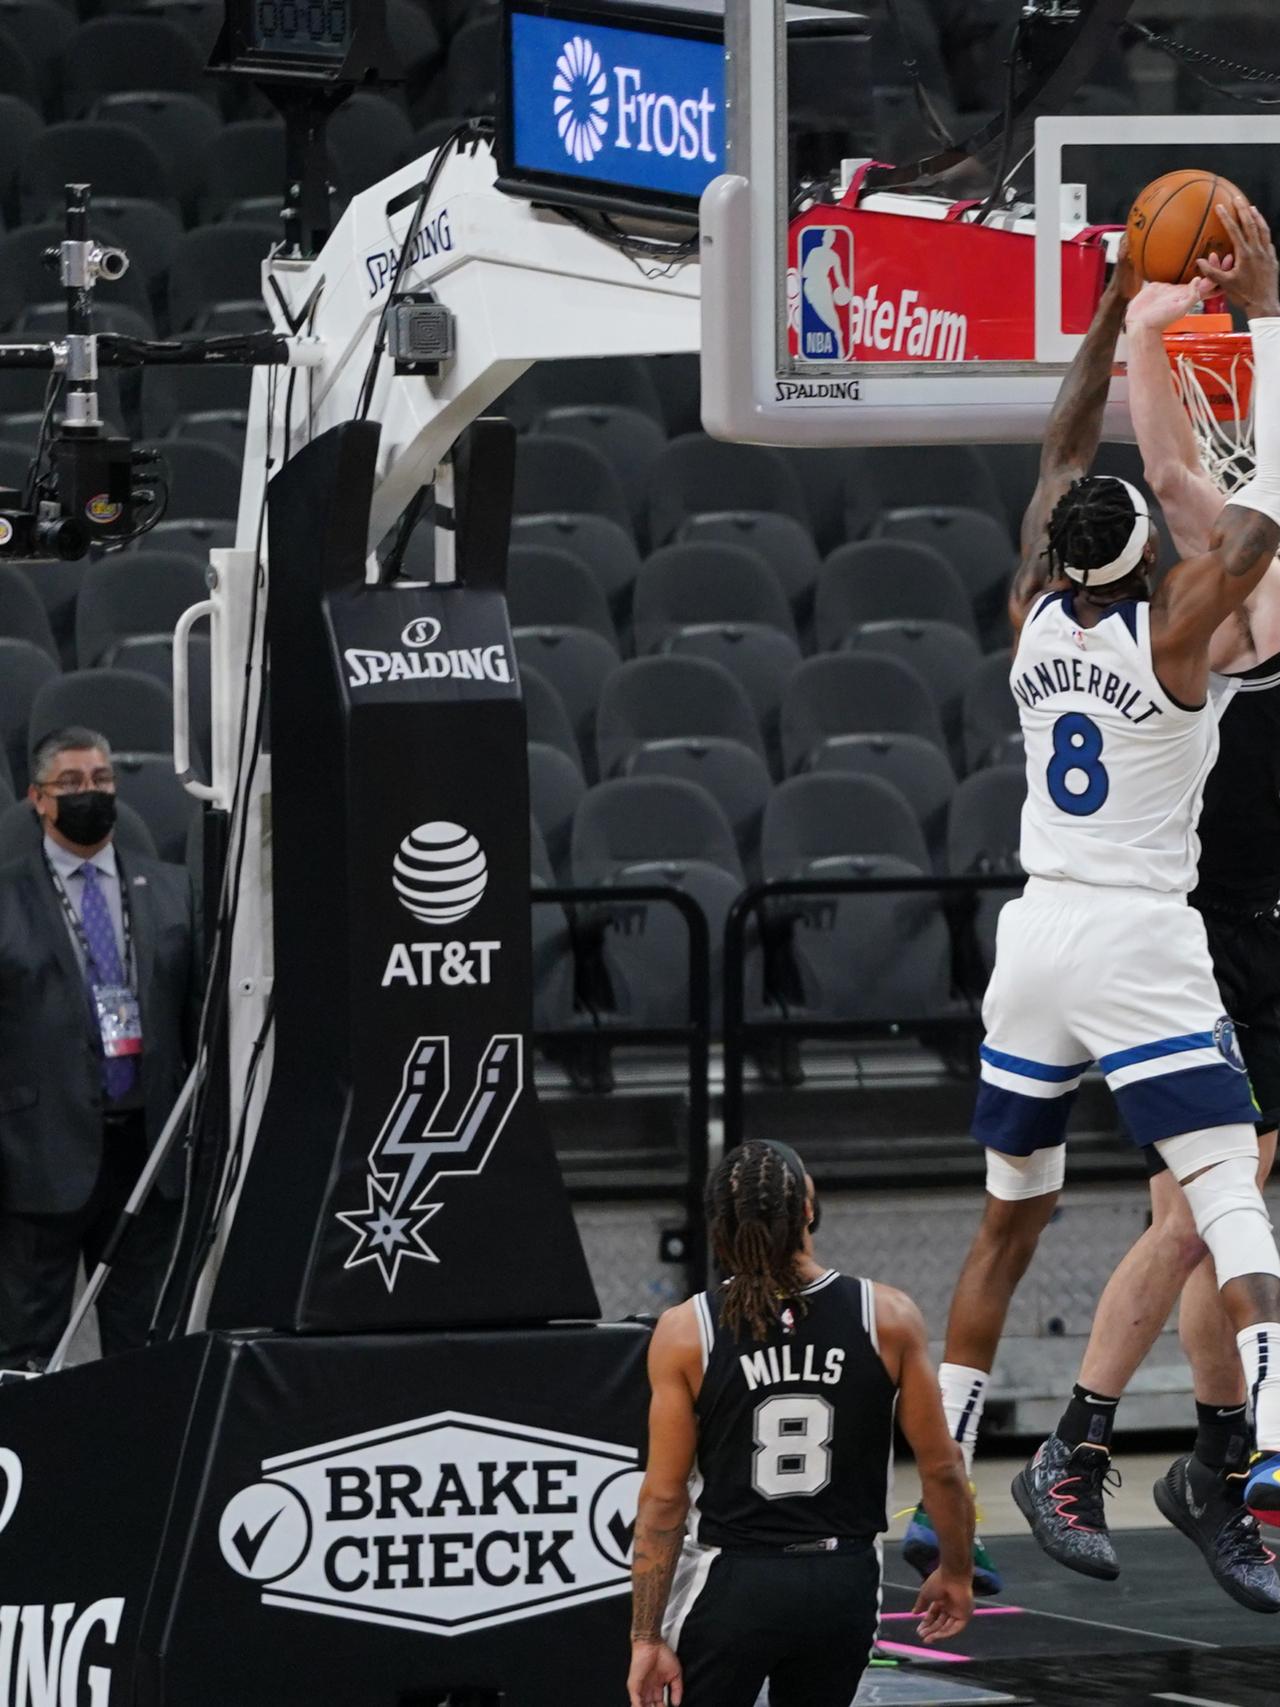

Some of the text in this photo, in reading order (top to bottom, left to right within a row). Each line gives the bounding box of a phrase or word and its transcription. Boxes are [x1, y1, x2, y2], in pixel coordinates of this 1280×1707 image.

[613, 66, 717, 163] Frost
[806, 331, 833, 354] NBA
[775, 381, 860, 402] SPALDING
[344, 645, 511, 688] SPALDING
[1014, 658, 1163, 725] VANDERBILT
[1046, 711, 1110, 817] 8
[381, 941, 501, 986] AT&T
[739, 1344, 845, 1391] MILLS
[751, 1393, 835, 1501] 8
[325, 1460, 577, 1521] BRAKE
[324, 1530, 576, 1592] CHECK
